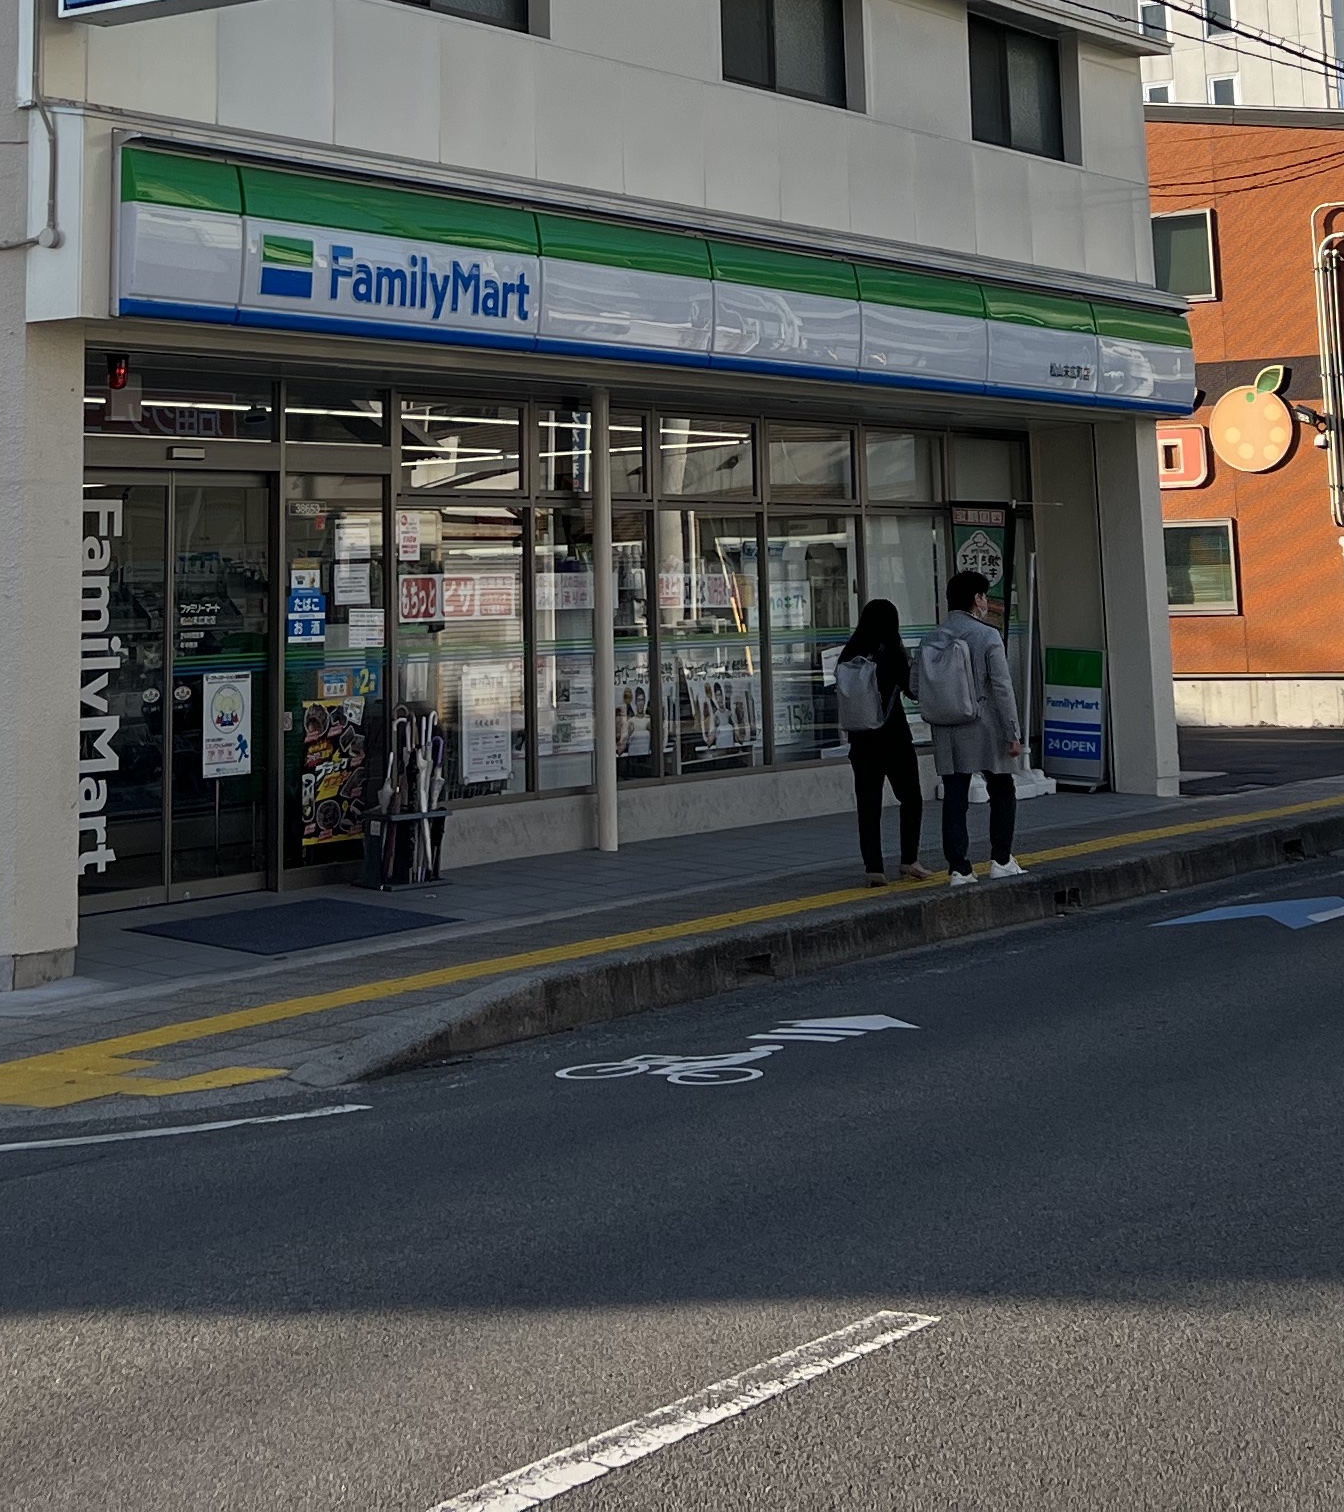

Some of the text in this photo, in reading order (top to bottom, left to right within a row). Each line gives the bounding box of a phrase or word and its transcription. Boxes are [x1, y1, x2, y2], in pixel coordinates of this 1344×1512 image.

[329, 245, 531, 320] FamilyMart
[179, 602, 221, 614] ファミリーマート
[293, 597, 321, 612] たばこ
[78, 499, 124, 876] FamilyMart
[1047, 697, 1100, 710] FamilyMart
